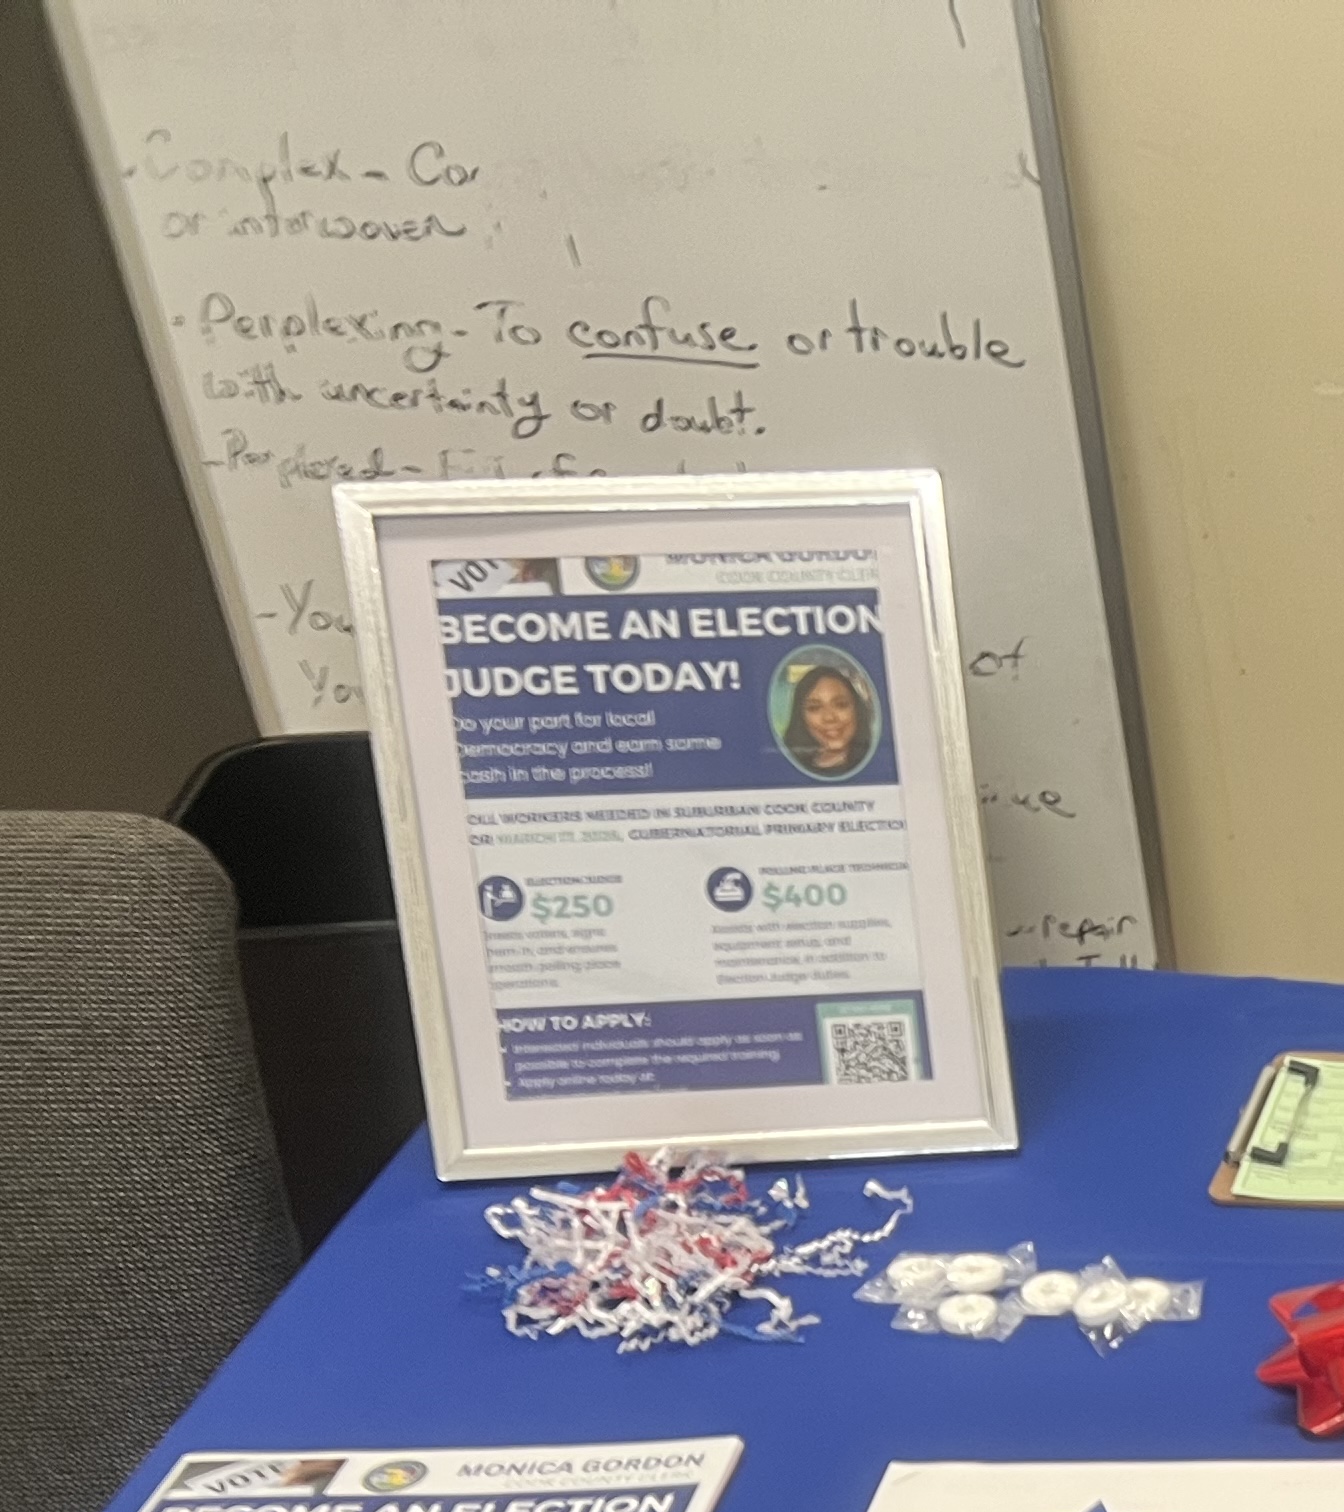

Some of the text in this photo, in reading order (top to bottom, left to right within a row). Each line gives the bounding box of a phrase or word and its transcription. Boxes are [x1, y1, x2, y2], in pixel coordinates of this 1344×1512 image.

[474, 299, 543, 346] To
[787, 328, 834, 356] or
[847, 297, 1026, 368] trouble
[440, 602, 885, 645] BECOME AN ELECTION
[444, 657, 742, 699] JUDGE TODAY!
[531, 892, 618, 925] $250
[762, 880, 849, 913] $400
[455, 1460, 575, 1480] MONICA
[579, 1451, 706, 1476] GORDON
